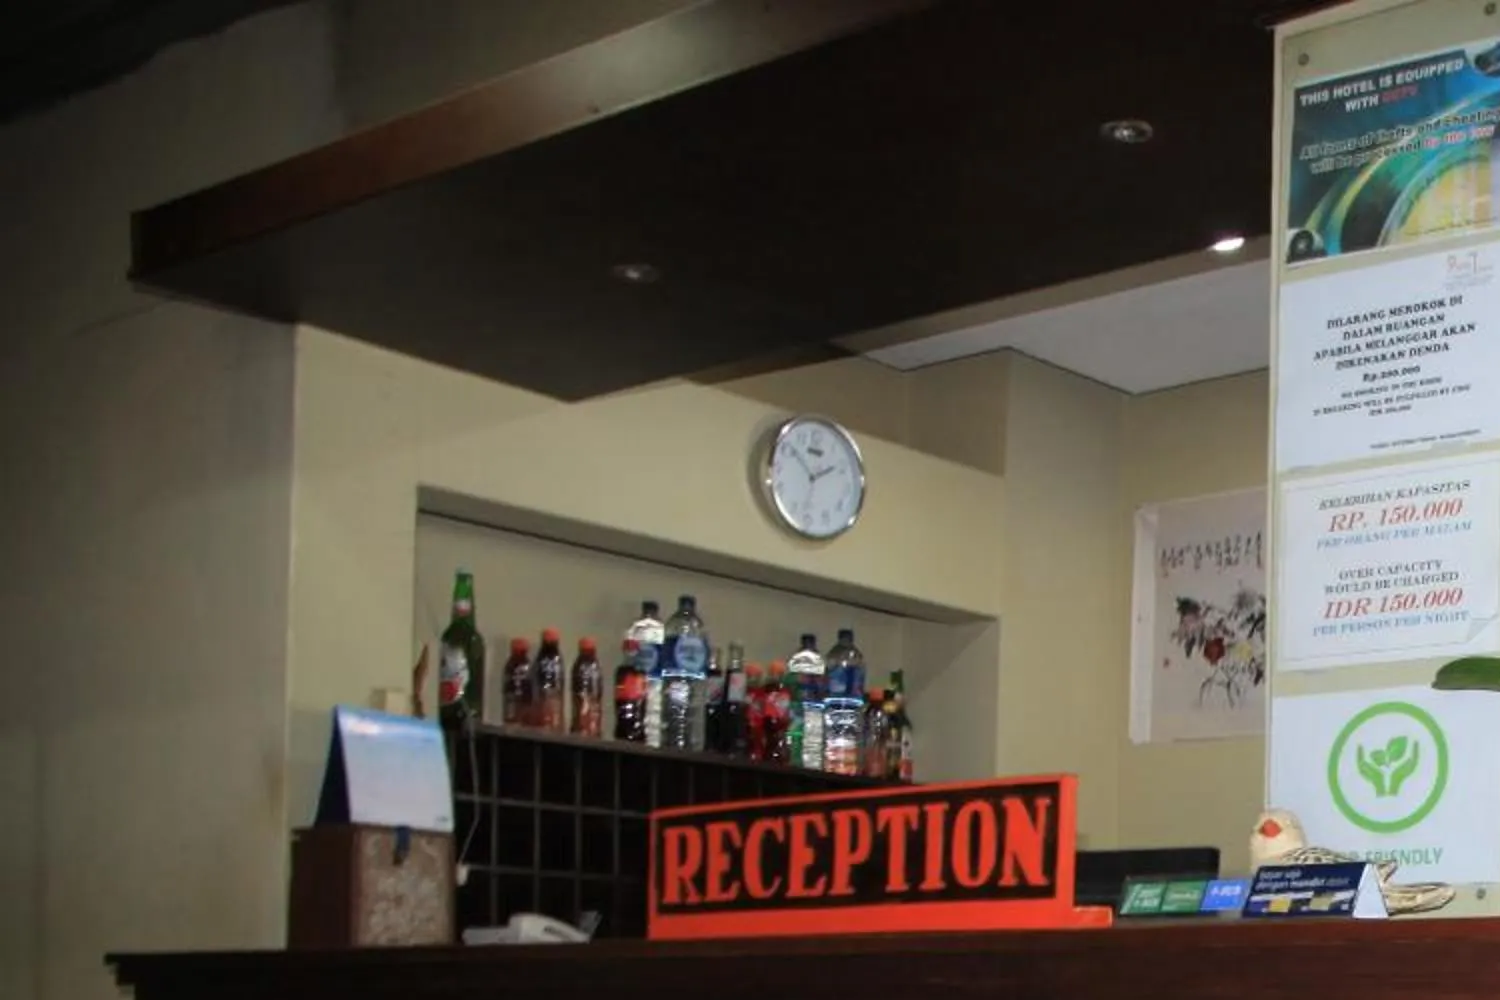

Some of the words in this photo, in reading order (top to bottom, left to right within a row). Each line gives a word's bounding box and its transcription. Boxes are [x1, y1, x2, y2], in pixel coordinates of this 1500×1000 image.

[1299, 90, 1329, 107] THIS
[1333, 77, 1376, 98] HOTEL
[1379, 74, 1393, 88] IS
[1396, 58, 1465, 85] EQUIPPED
[1345, 94, 1380, 113] WITH
[1327, 309, 1386, 329] DILARANG
[1389, 298, 1447, 318] MEROKOK
[1449, 295, 1463, 306] DI
[1343, 324, 1383, 341] DALAM
[1386, 314, 1446, 333] RUANGAN
[1313, 343, 1361, 361] APABILA
[1365, 330, 1438, 349] MELANGGAR
[1441, 323, 1476, 337] AKAN
[1335, 350, 1406, 371] DIKENAKAN
[1409, 342, 1451, 357] DENDA
[1318, 490, 1392, 511] KELEBIHAN
[1395, 480, 1471, 500] KAPASITAS
[1379, 498, 1464, 526] 150.000
[1393, 527, 1421, 540] PER
[1424, 520, 1473, 536] MALAM
[1324, 580, 1372, 595] WOULD
[1375, 578, 1391, 589] BE
[1393, 571, 1459, 588] CHARGED
[1338, 567, 1374, 581] OVER
[1377, 559, 1443, 576] CAPACITY
[1324, 597, 1371, 620] IDR
[1379, 587, 1464, 614] 150.000
[1313, 623, 1338, 637] PER
[1341, 618, 1390, 634] PERSON
[1394, 614, 1421, 628] PER
[1424, 610, 1469, 623] NIGHT
[662, 796, 1054, 906] RECEPTION
[1366, 847, 1443, 865] FRIENDLY
